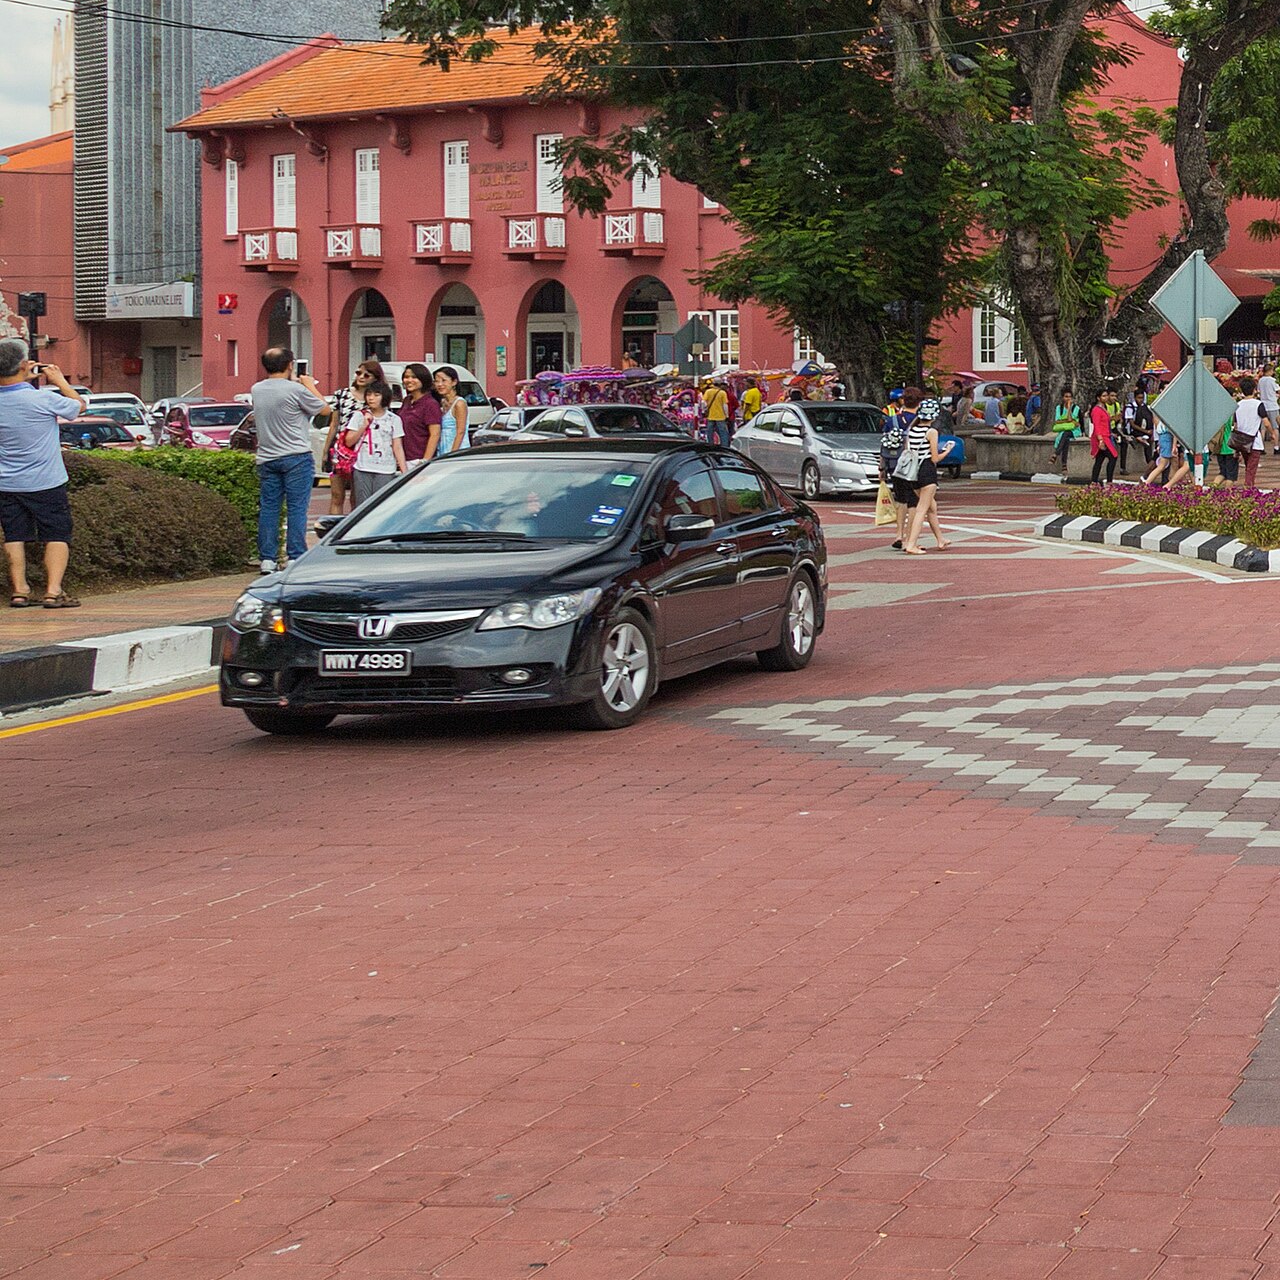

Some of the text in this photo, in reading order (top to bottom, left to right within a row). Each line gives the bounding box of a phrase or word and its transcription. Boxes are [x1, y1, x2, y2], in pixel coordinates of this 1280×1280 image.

[124, 294, 182, 306] TOKIO MARINE LIFE
[358, 653, 404, 669] 4998
